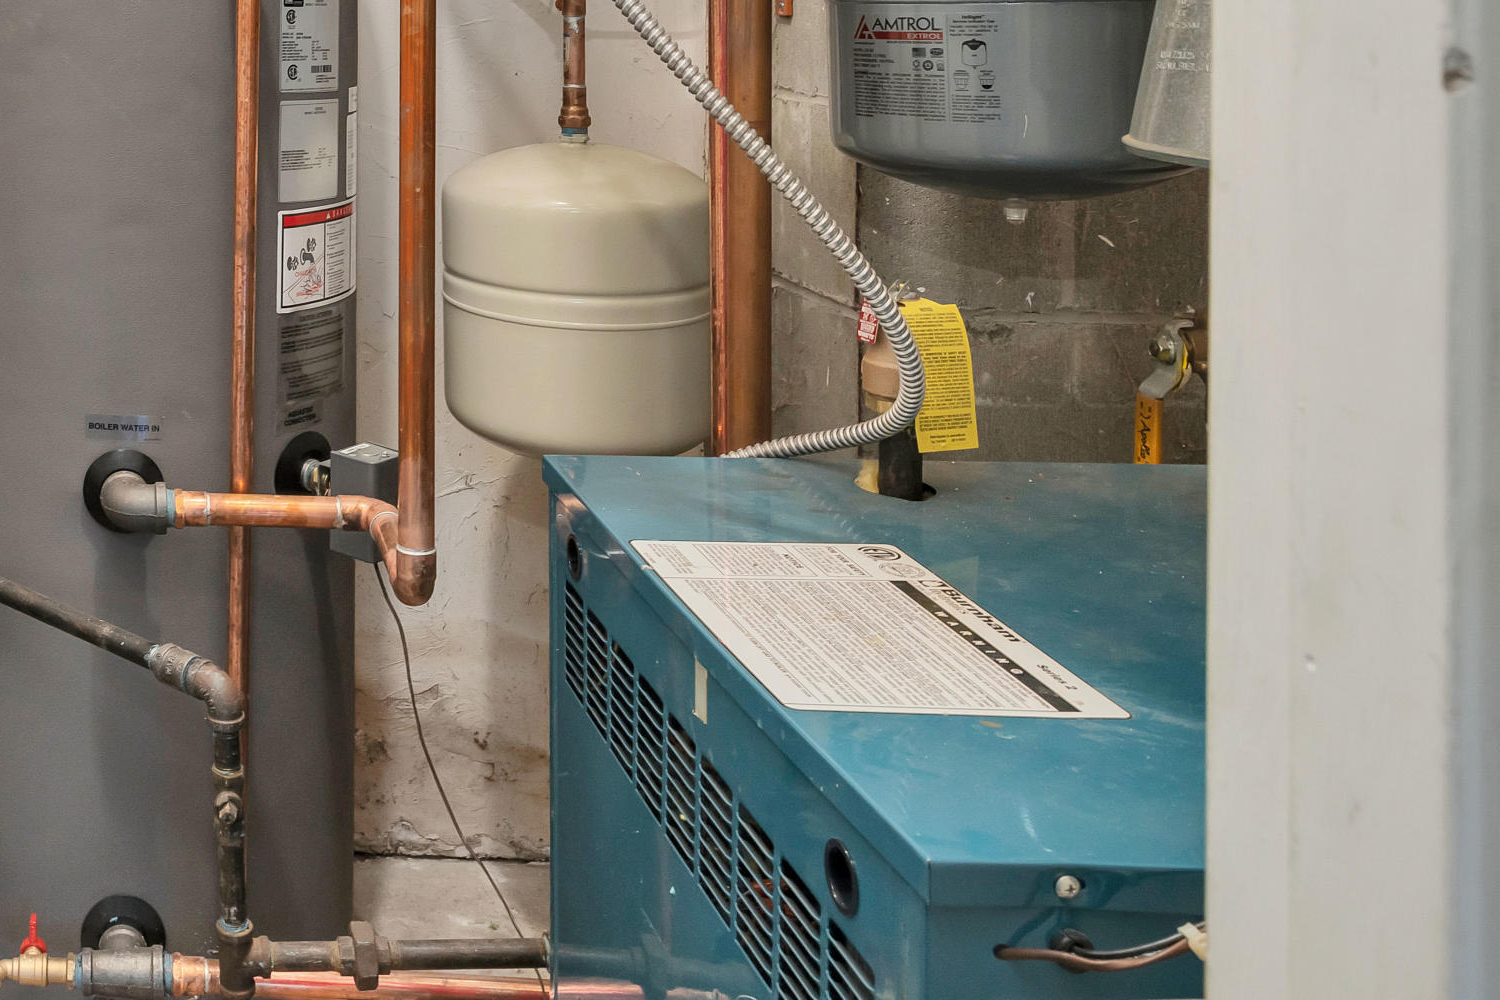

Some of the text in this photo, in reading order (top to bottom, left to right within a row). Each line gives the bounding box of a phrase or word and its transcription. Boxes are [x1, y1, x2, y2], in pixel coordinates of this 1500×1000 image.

[873, 17, 941, 31] AMTROL
[907, 32, 943, 40] EXTROL
[88, 422, 119, 431] BOILER
[120, 424, 150, 432] WATER
[940, 586, 1022, 642] Burnham
[933, 611, 1024, 675] WARNING
[1036, 664, 1067, 684] Series
